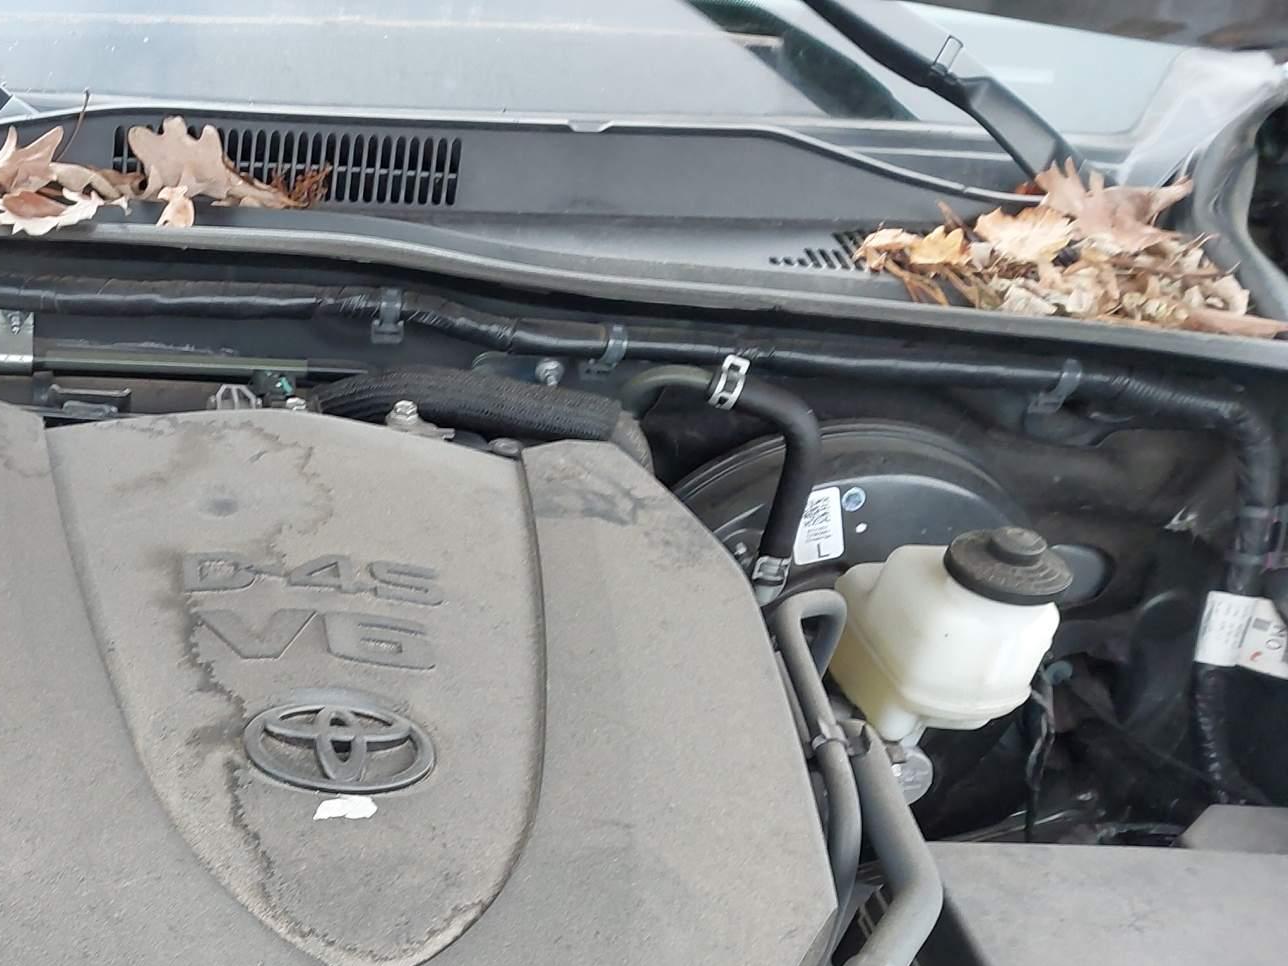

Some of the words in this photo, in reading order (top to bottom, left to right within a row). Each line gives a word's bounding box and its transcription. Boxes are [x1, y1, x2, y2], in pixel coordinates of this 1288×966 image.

[182, 551, 447, 607] D-4S
[816, 543, 831, 559] L
[192, 608, 437, 671] V6
